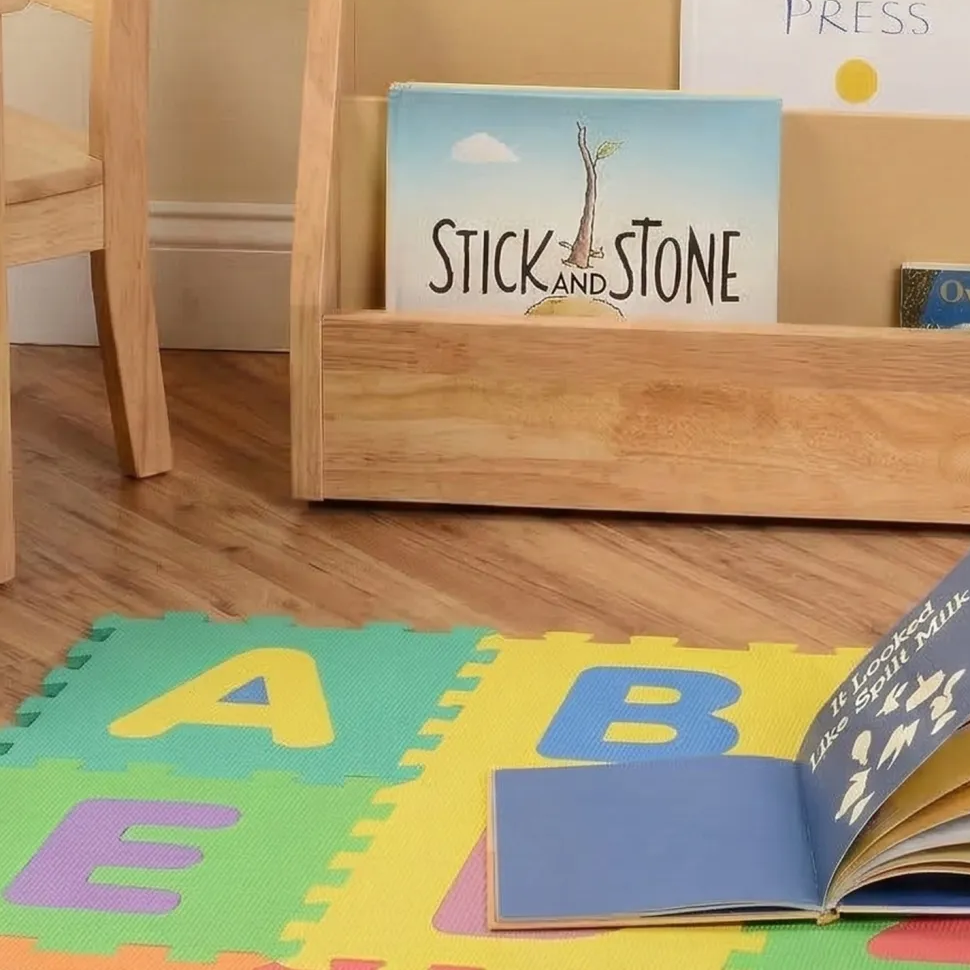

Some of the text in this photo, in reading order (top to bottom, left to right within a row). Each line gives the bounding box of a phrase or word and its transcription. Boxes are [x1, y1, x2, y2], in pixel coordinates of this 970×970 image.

[428, 216, 742, 306] STICK AND STONE
[107, 647, 336, 749] A
[855, 648, 910, 715] Spilt
[913, 589, 970, 652] Milk
[535, 665, 742, 763] B
[2, 797, 244, 916] E
